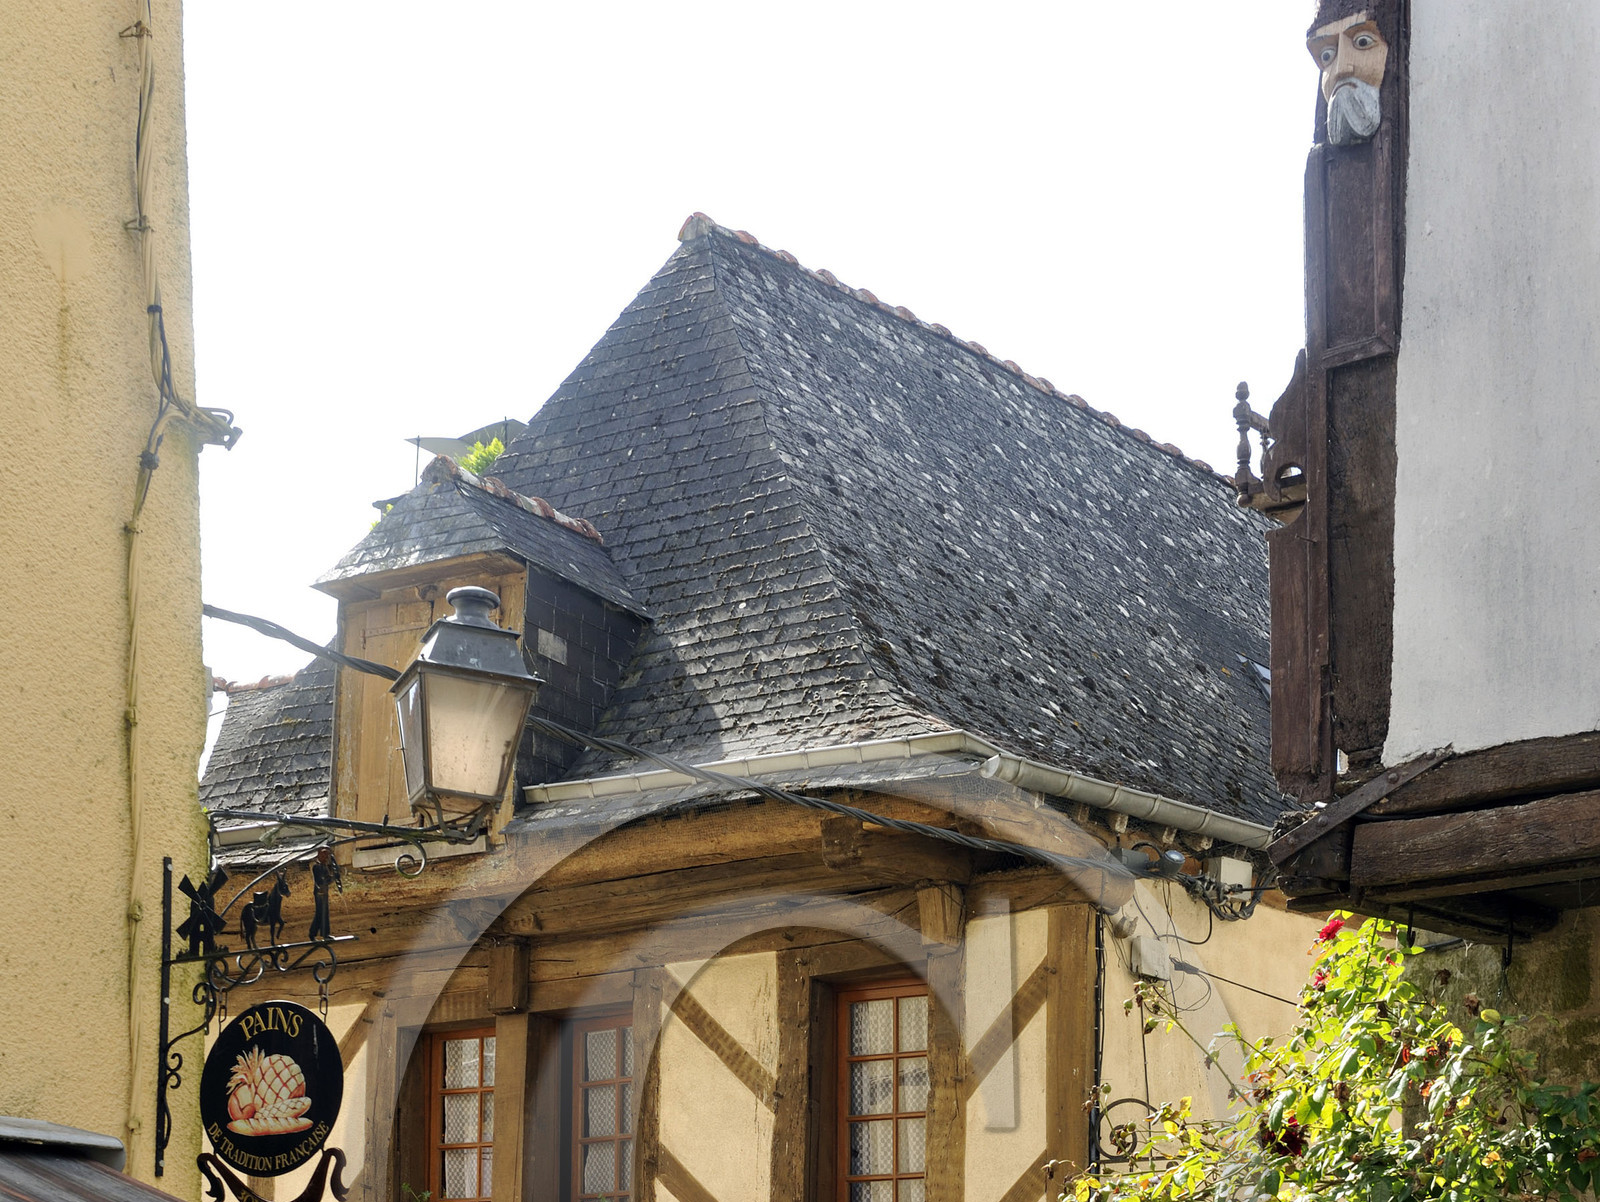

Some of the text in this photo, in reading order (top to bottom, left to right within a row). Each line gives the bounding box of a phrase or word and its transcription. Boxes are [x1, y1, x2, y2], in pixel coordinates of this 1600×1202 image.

[238, 1007, 304, 1041] PAINS
[207, 1120, 330, 1171] DE TRADITION FRANÇAISE
